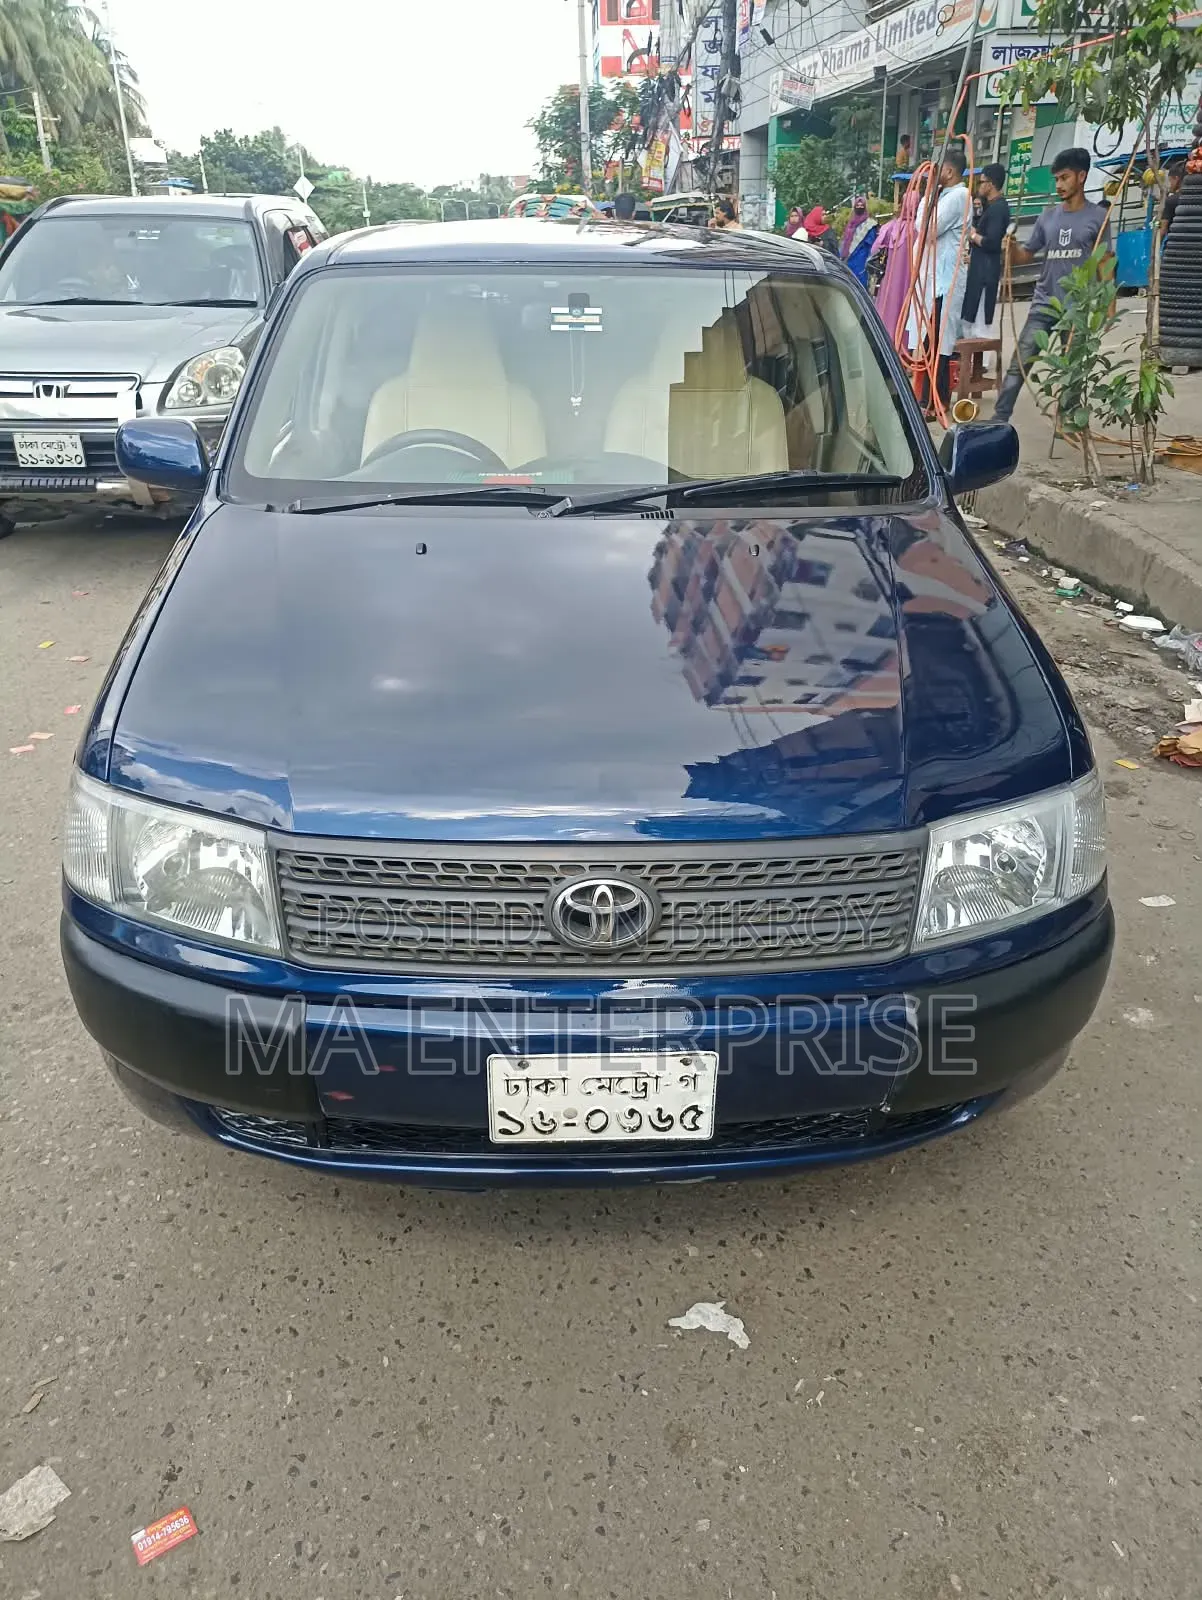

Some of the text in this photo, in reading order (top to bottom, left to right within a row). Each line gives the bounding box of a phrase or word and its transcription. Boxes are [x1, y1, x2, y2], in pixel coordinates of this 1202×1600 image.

[821, 36, 870, 77] Pharma
[876, 3, 938, 50] Limited
[18, 441, 38, 450] ঢাকা
[18, 454, 83, 465] ১১-৯৩২০
[503, 1073, 570, 1097] ঢাকা
[497, 1104, 704, 1136] ১৬-০৩৬৫
